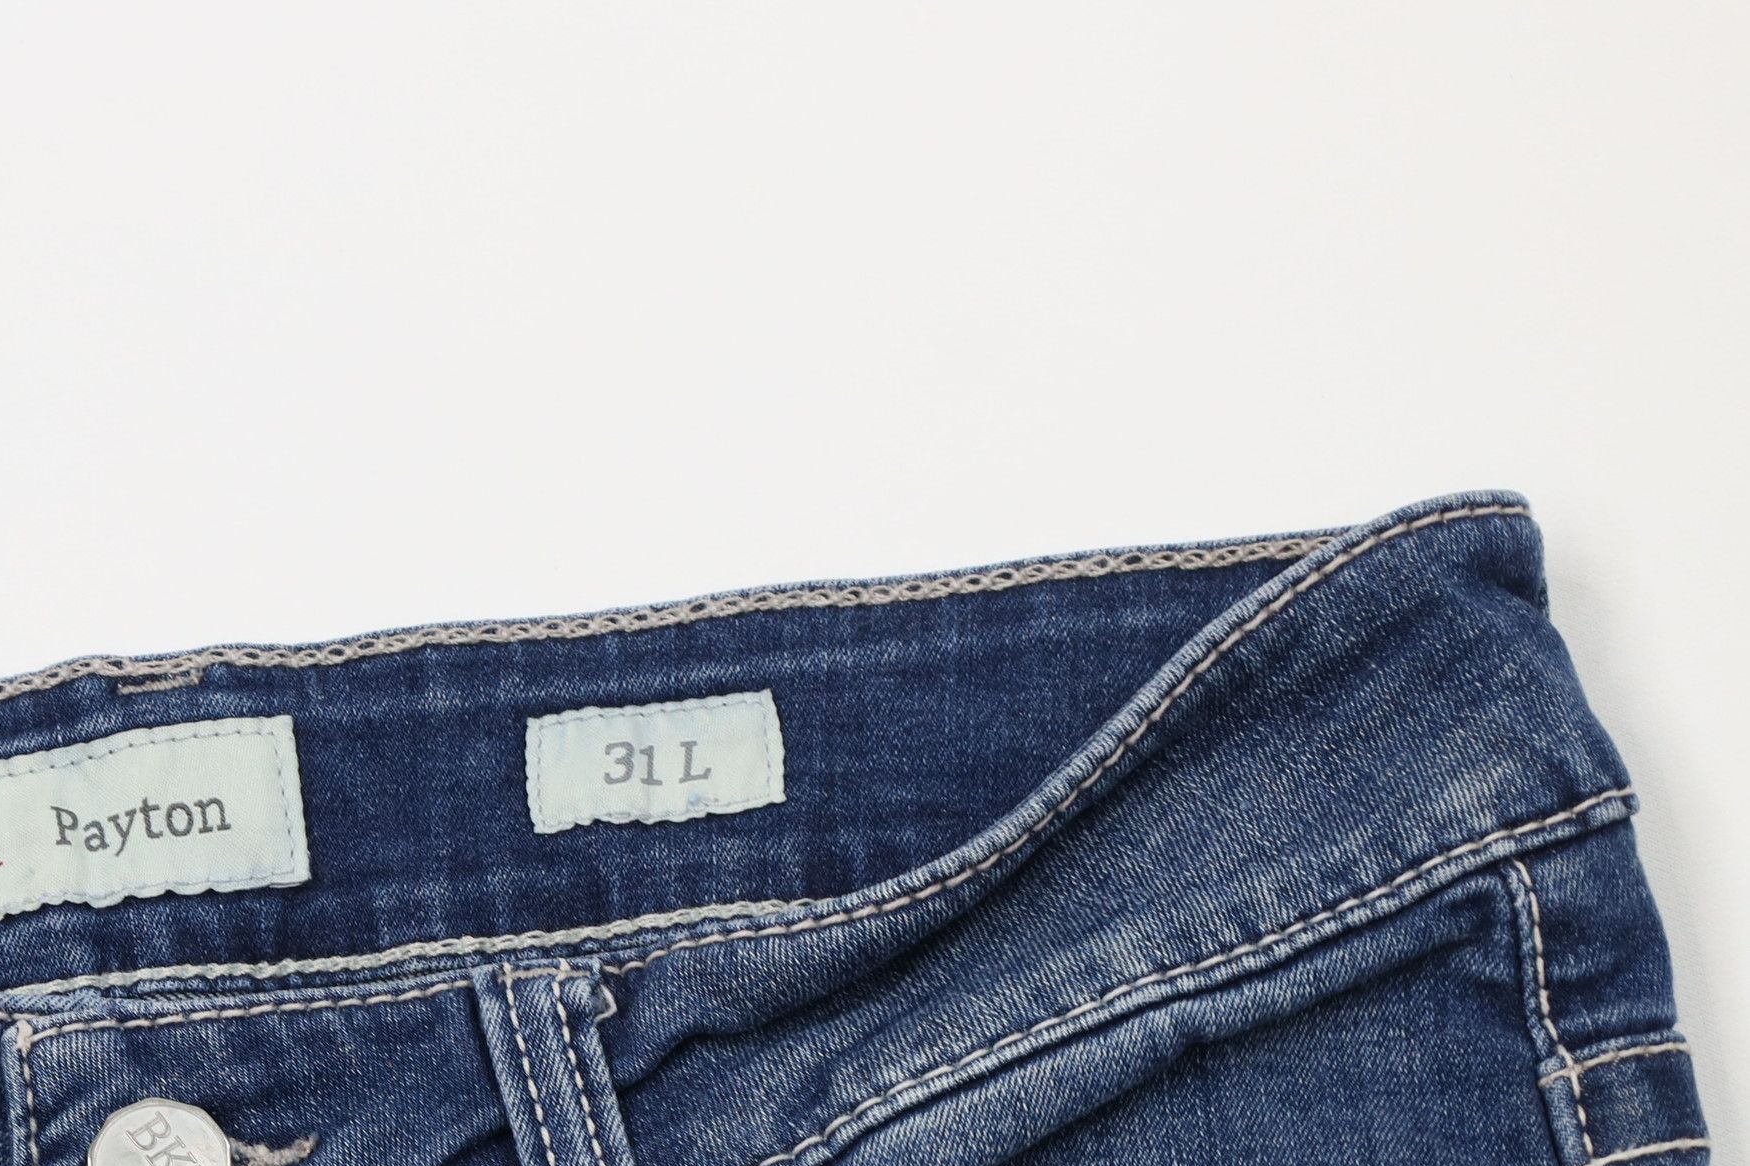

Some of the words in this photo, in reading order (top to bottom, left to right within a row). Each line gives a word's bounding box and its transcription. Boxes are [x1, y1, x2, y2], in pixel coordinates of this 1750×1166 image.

[603, 741, 663, 786] 31
[678, 740, 712, 784] L
[49, 795, 232, 856] Payton
